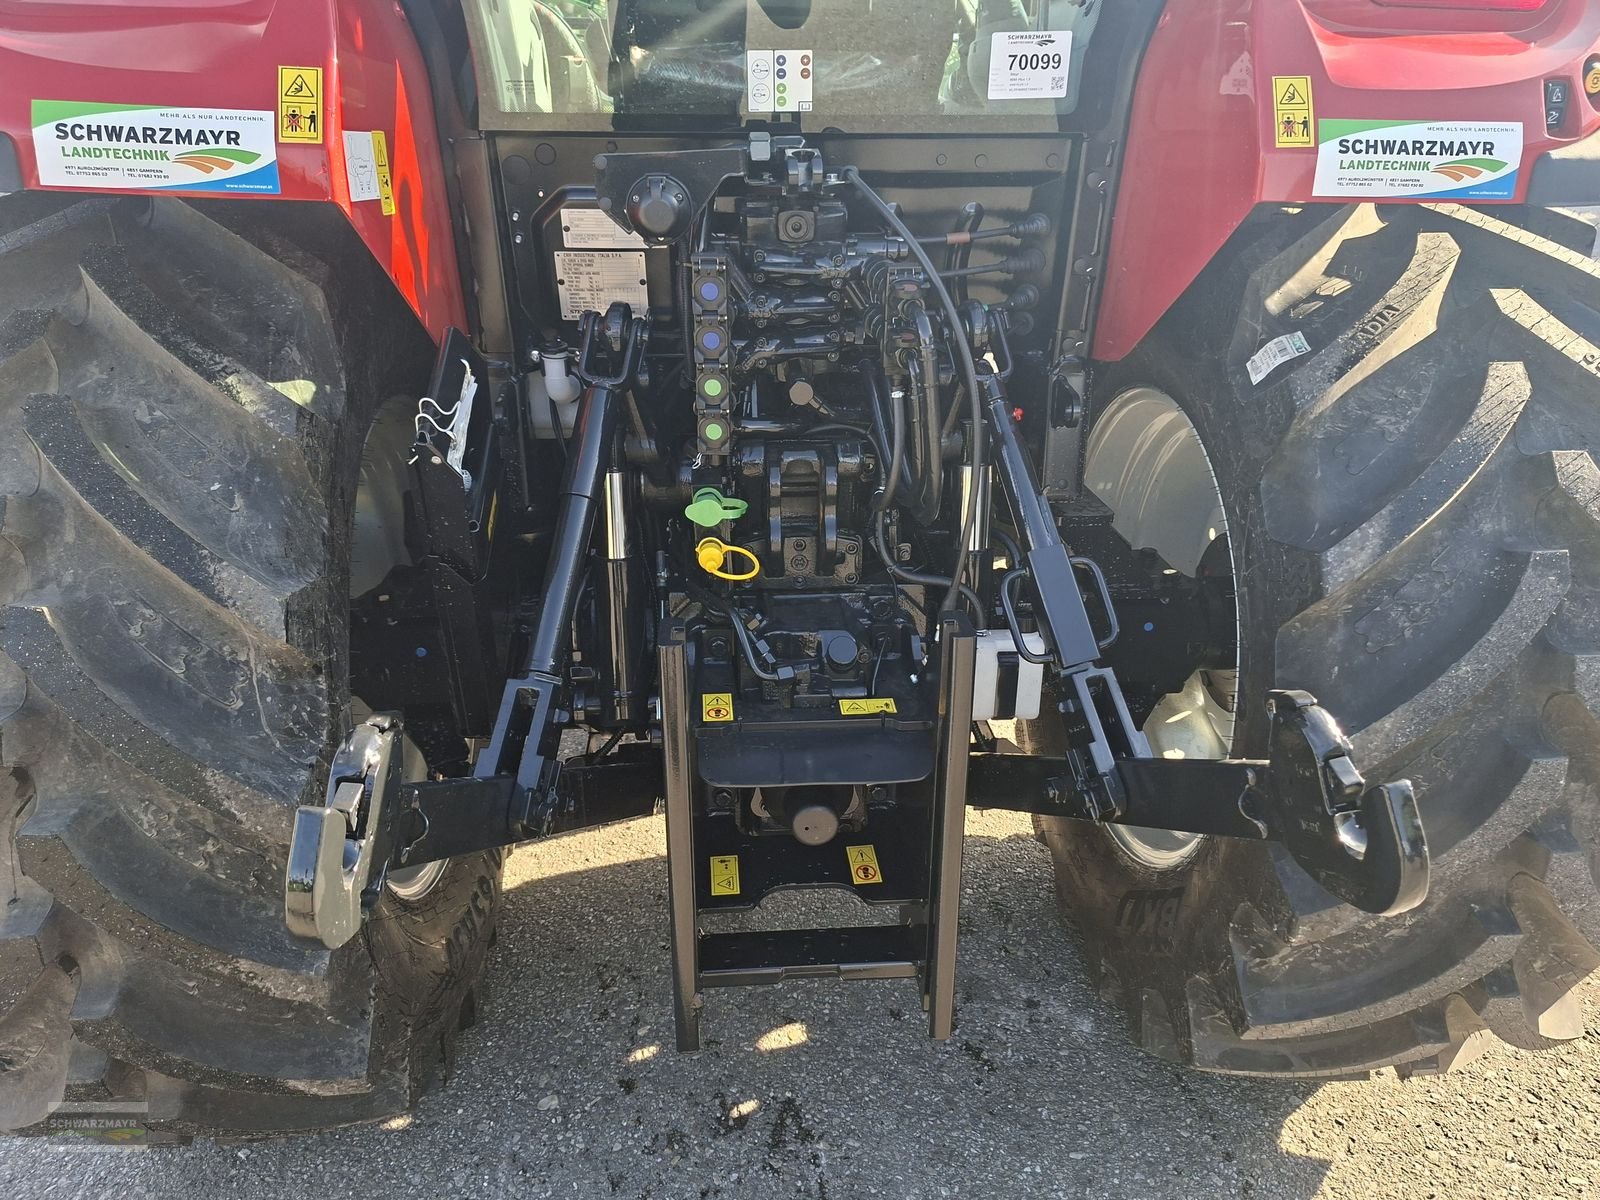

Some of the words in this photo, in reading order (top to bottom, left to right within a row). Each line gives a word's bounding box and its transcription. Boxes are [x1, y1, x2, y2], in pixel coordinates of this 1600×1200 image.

[1008, 53, 1062, 71] 70099
[54, 122, 240, 146] SCHWARZMAYR
[61, 146, 170, 161] LANDTECHNIK
[1338, 138, 1495, 156] SCHWARZMAYR
[1339, 160, 1431, 171] LANDTECHNIK
